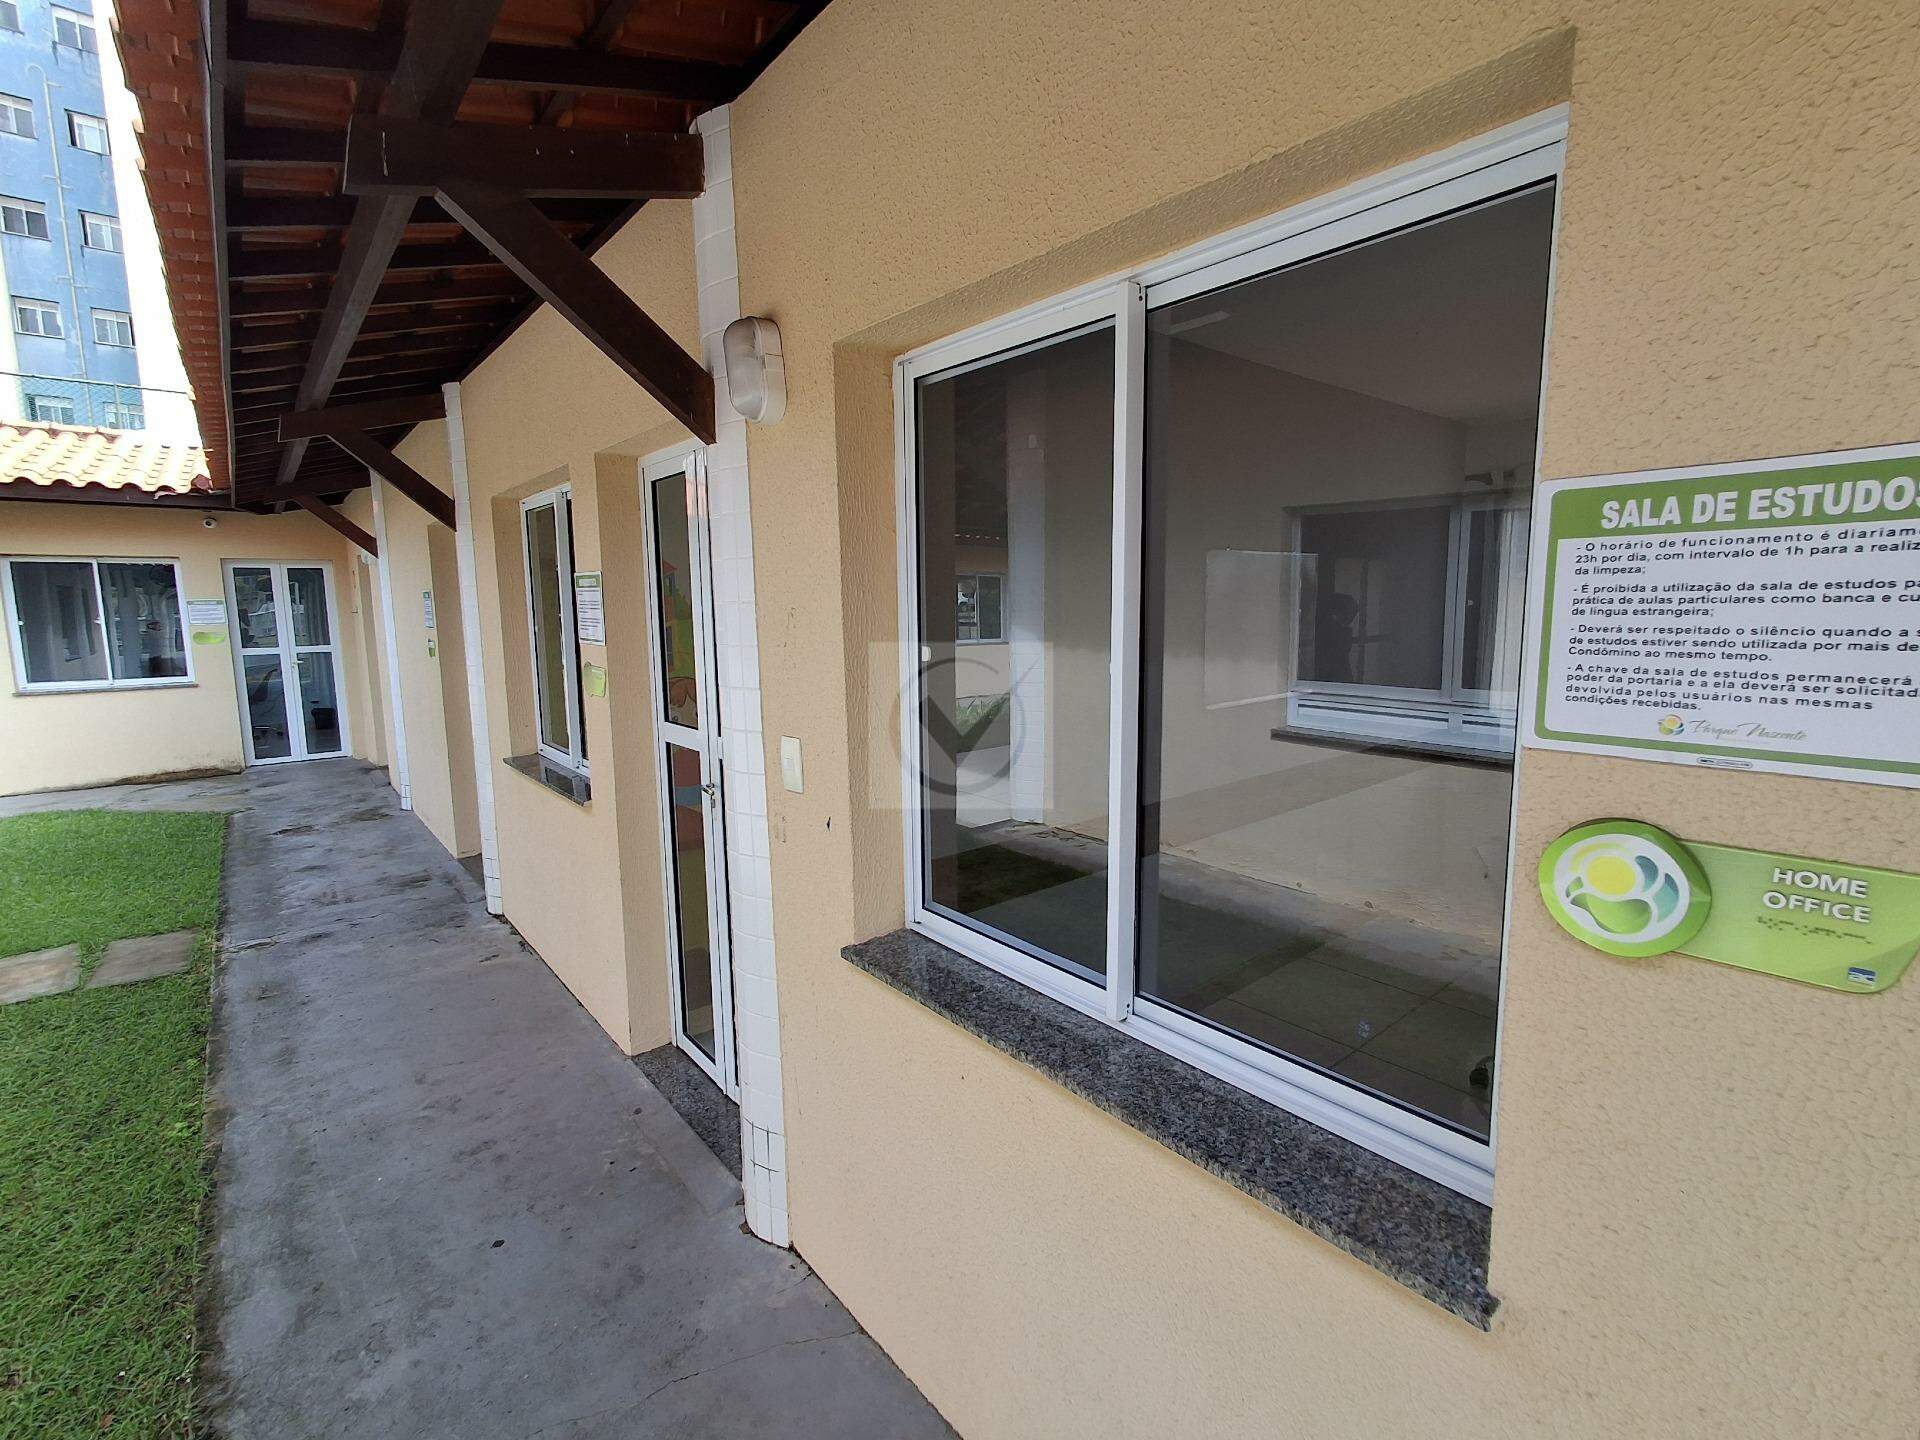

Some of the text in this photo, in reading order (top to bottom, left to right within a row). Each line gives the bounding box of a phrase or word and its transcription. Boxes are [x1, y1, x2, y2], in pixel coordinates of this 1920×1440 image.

[1601, 476, 1920, 529] SALA DE ESTUDO
[1586, 543, 1595, 551] O
[1600, 541, 1652, 550] horário
[1659, 540, 1676, 548] de
[1682, 533, 1813, 548] funcionamento
[1821, 530, 1829, 540] é
[1838, 528, 1920, 539] diariam
[1576, 553, 1597, 564] 23h
[1602, 555, 1622, 564] por
[1628, 552, 1650, 562] dia,
[1655, 552, 1684, 560] com
[1690, 549, 1754, 560] intervalo
[1760, 547, 1778, 556] de
[1785, 546, 1803, 555] 1h
[1810, 545, 1847, 557] para
[1575, 566, 1646, 576] da limpeza;
[1594, 584, 1646, 594] proibida
[1663, 583, 1730, 593] utilização
[1737, 582, 1754, 591] da
[1760, 581, 1792, 591] sala
[1799, 581, 1818, 590] de
[1825, 579, 1897, 590] estudos
[1573, 596, 1613, 606] prática
[1619, 596, 1633, 604] de
[1638, 595, 1673, 604] aulas
[1678, 595, 1765, 606] particulares
[1772, 595, 1815, 603] como
[1822, 593, 1874, 603] banca
[1882, 594, 1891, 602] e
[1572, 607, 1585, 616] de
[1633, 607, 1715, 617] estrangeira;
[1578, 624, 1622, 633] Deverá
[1653, 626, 1730, 636] respeitado
[1750, 626, 1815, 636] silêncio
[1822, 627, 1891, 638] quando
[1898, 629, 1908, 637] a
[1570, 636, 1919, 652] de estudos estiver sendo utilizada por mais de
[1569, 647, 1640, 656] Condômino
[1665, 651, 1716, 659] mesmo
[1721, 651, 1772, 662] tempo.
[1575, 664, 1583, 672] A
[1588, 665, 1628, 674] chave
[1633, 667, 1649, 675] da
[1655, 667, 1684, 676] sala
[1690, 668, 1707, 677] de
[1713, 669, 1779, 680] estudos
[1786, 674, 1912, 686] permanecerá
[1566, 674, 1603, 682] poder
[1608, 675, 1622, 683] da
[1628, 677, 1682, 686] portaria
[1700, 680, 1707, 688] a
[1714, 680, 1734, 689] ela
[1741, 681, 1795, 692] deverá
[1802, 685, 1830, 694] ser
[1565, 695, 1701, 710] condições recebidas.
[1566, 684, 1873, 710] devolvida pelos usuários nas mesmas
[1772, 867, 1869, 898] HOME
[1763, 891, 1871, 923] OFFICE
